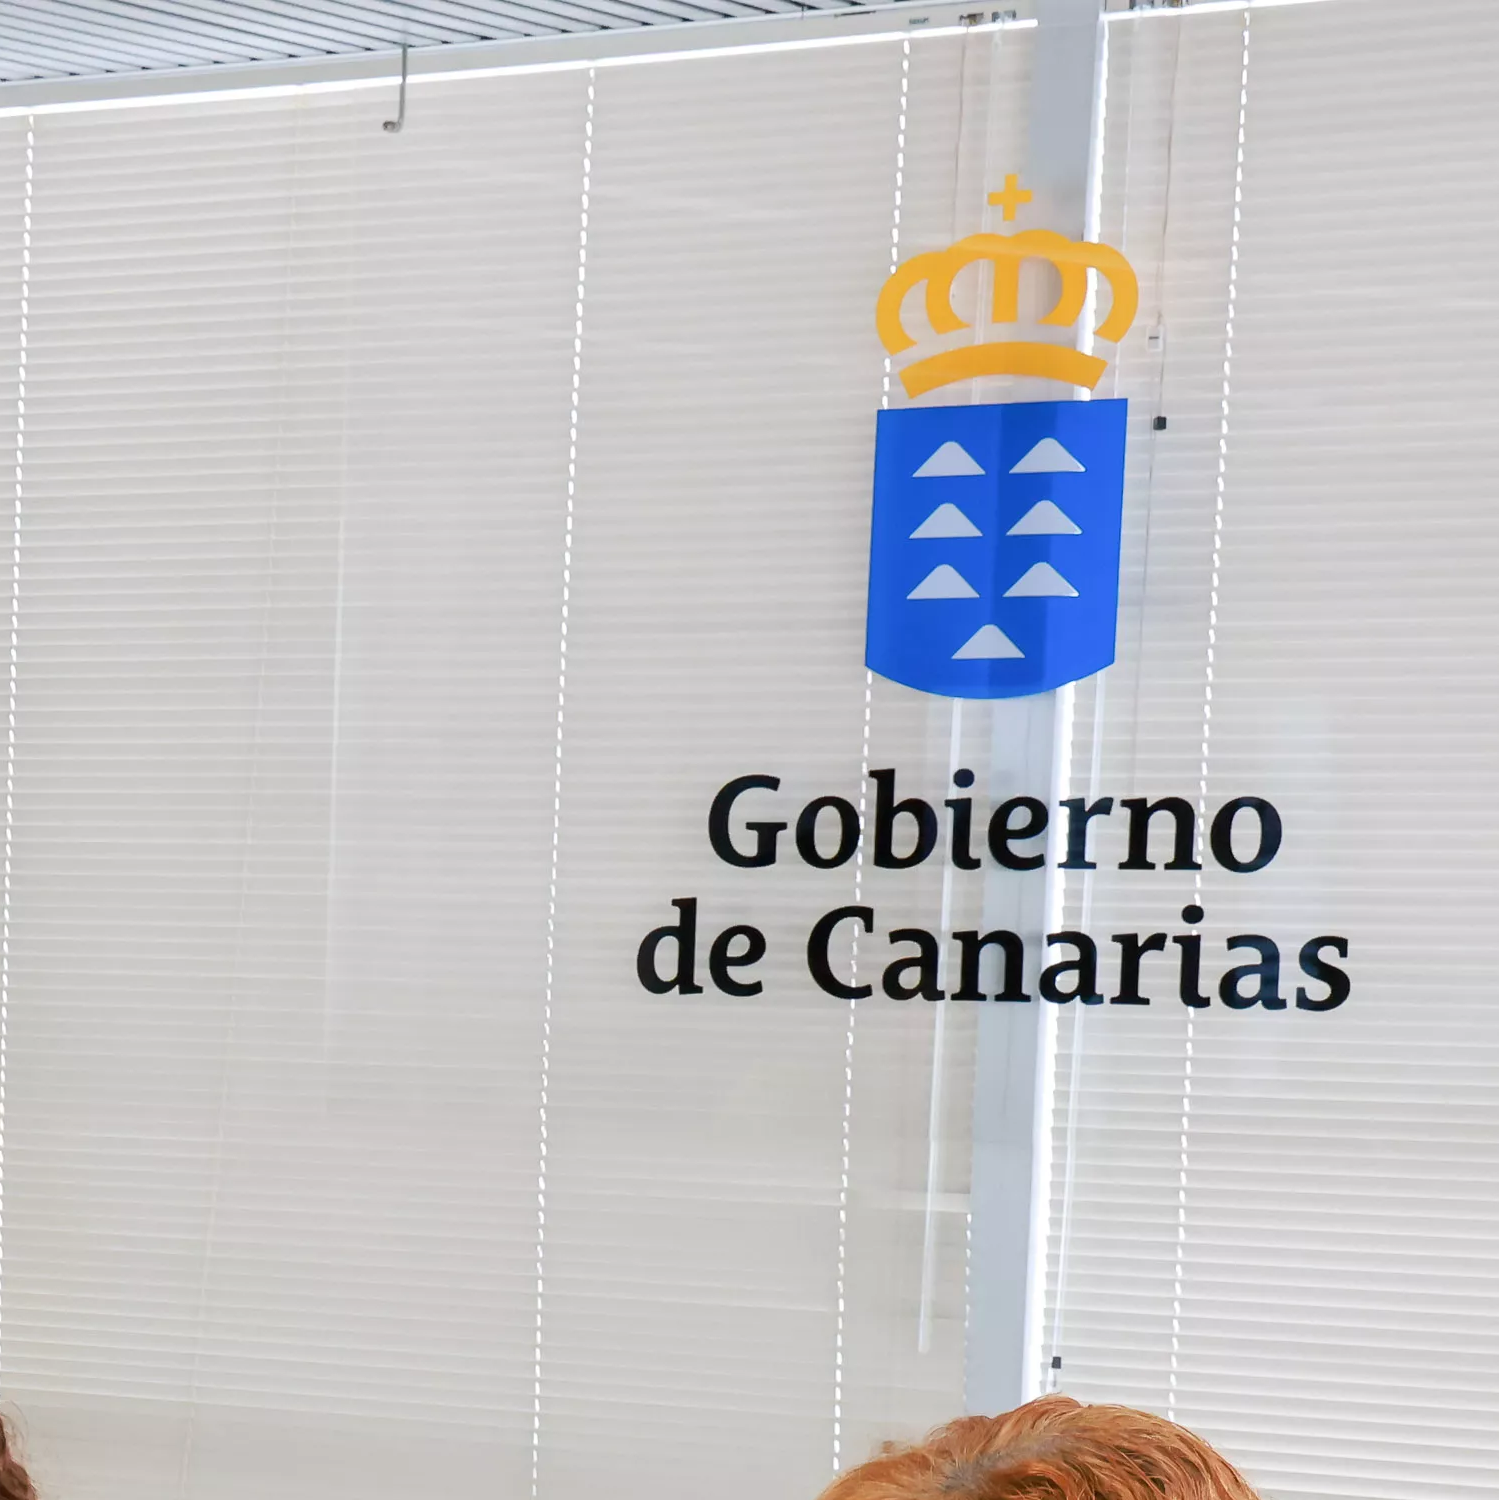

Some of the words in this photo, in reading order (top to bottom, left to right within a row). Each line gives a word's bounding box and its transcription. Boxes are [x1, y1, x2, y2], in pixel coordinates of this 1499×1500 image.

[707, 768, 1283, 873] Gobierno
[636, 897, 767, 997] de
[807, 904, 1351, 1011] Canarias
